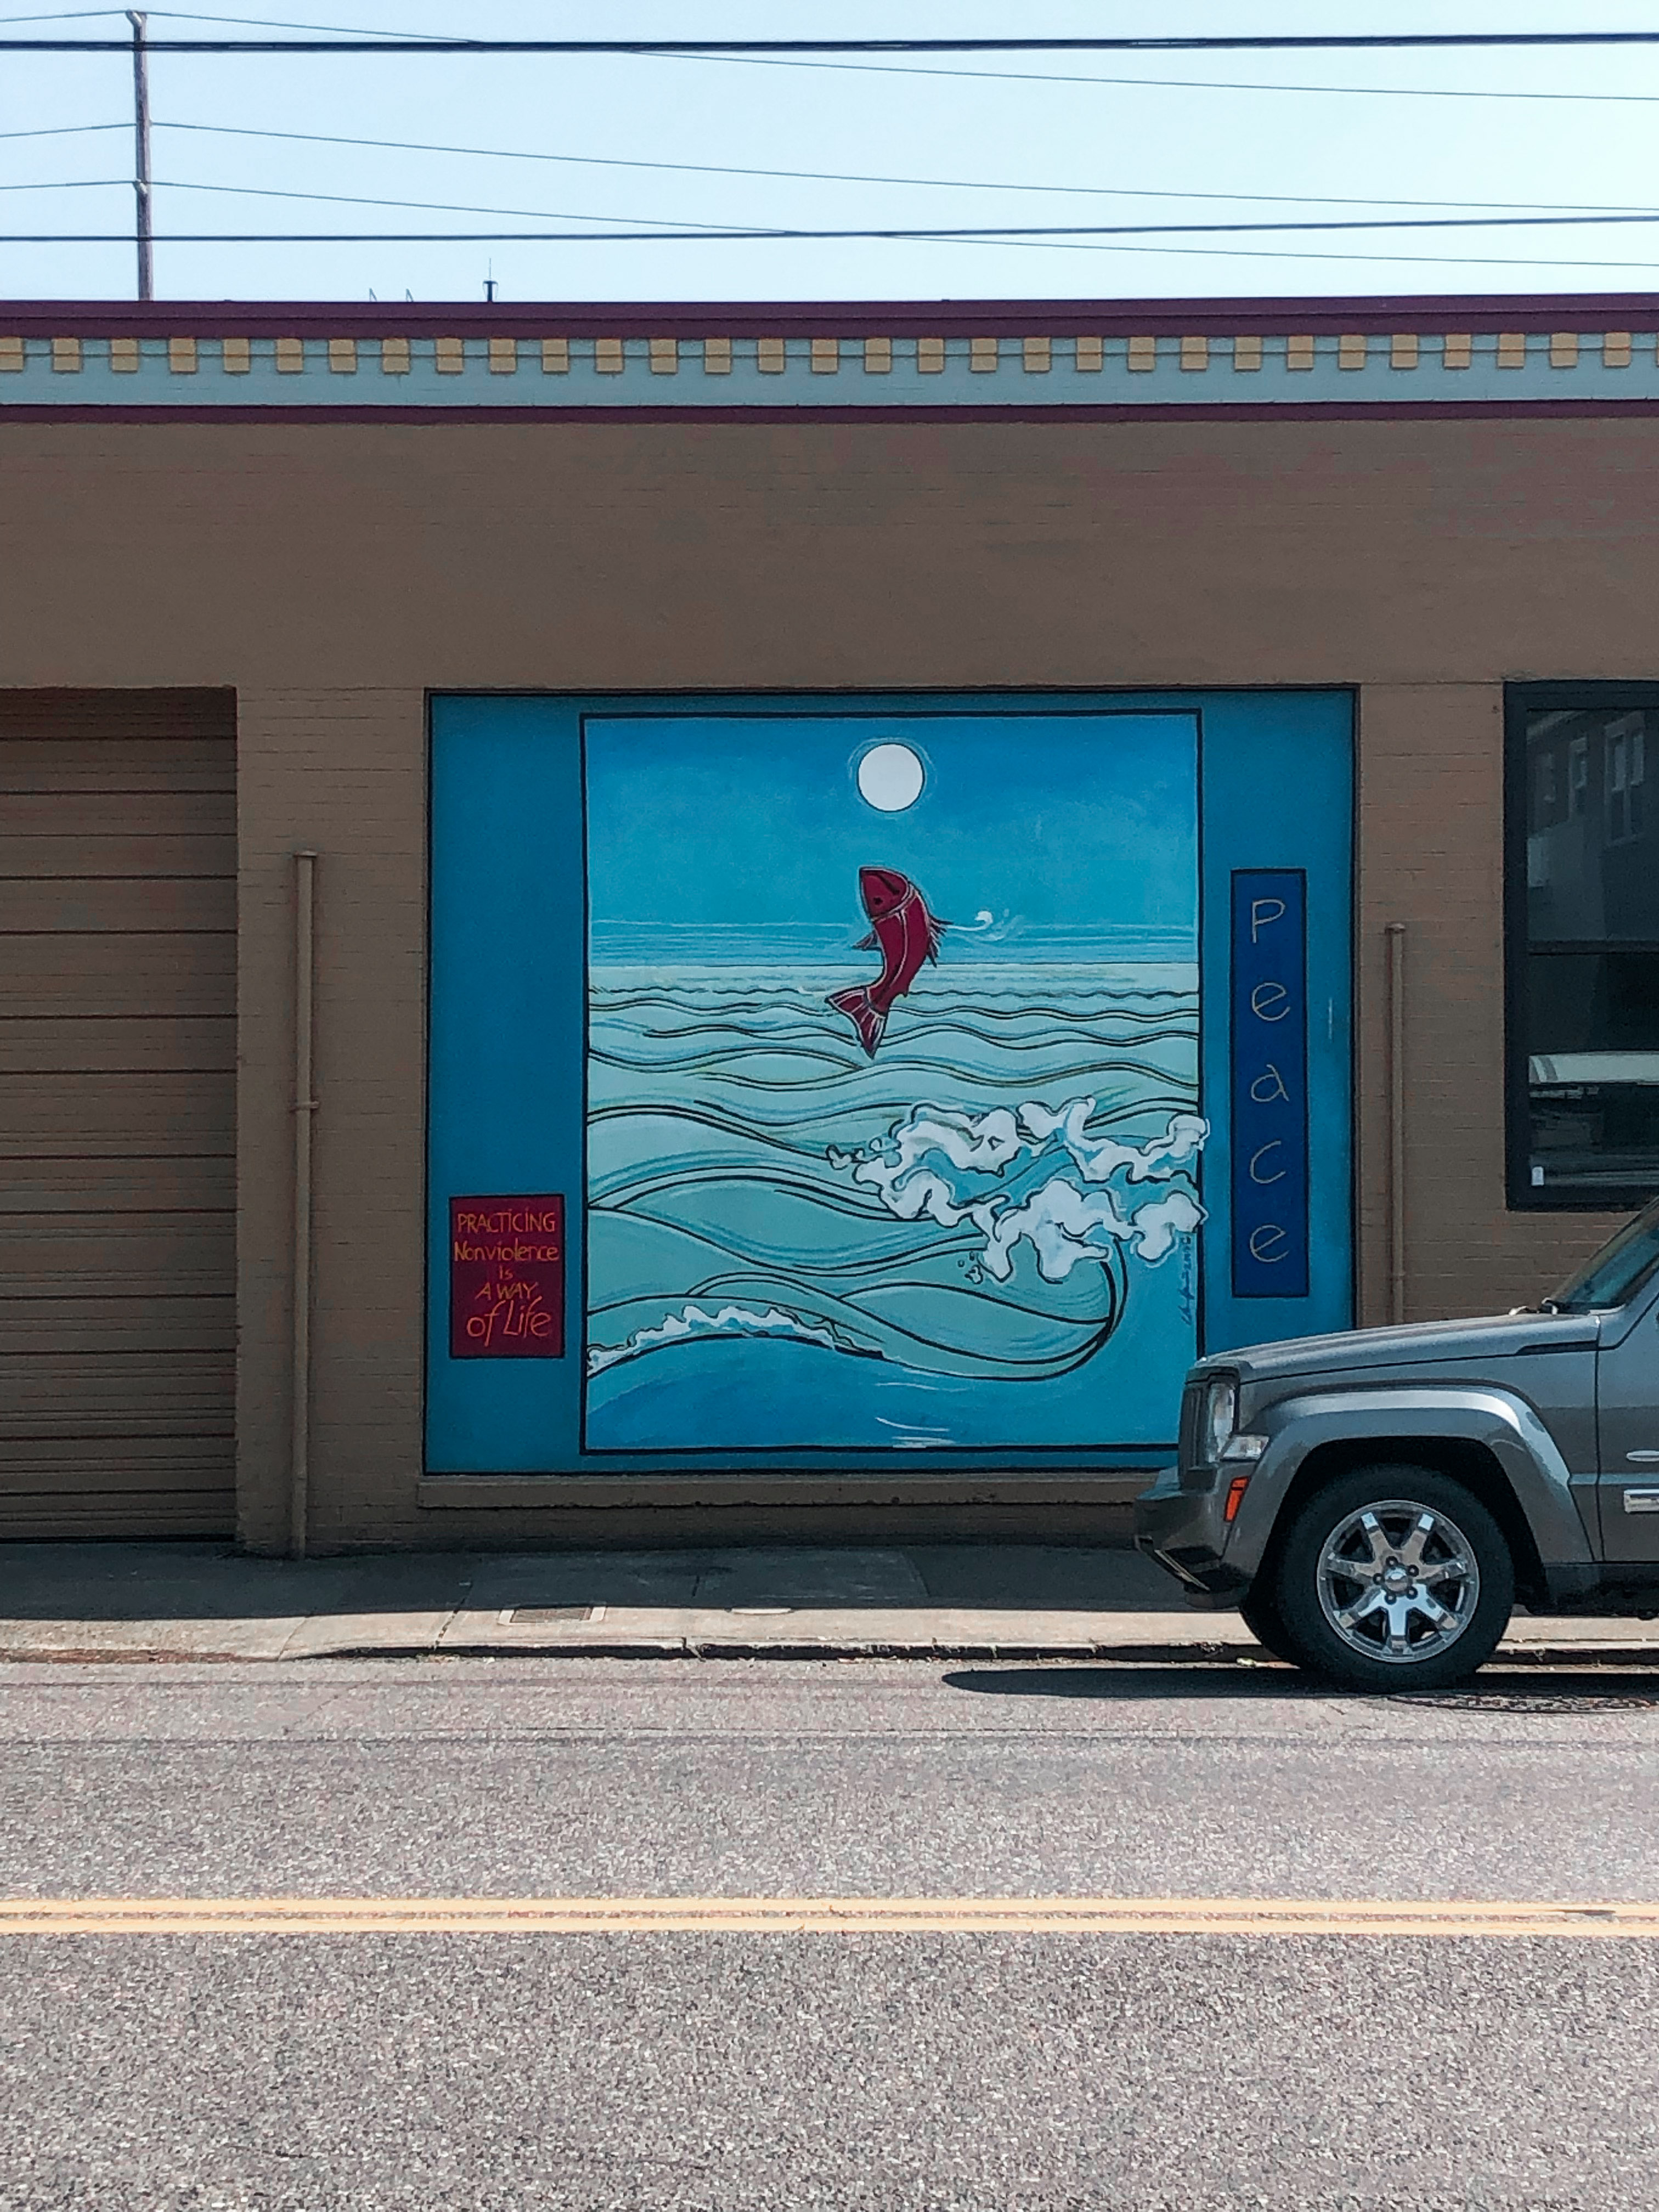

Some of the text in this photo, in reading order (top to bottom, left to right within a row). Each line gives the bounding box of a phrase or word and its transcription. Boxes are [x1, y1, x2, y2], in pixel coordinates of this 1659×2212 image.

[1250, 899, 1290, 1263] Peace
[458, 1207, 555, 1233] PRACTICING
[454, 1238, 559, 1261] Nonviolence
[475, 1282, 539, 1300] A WAY
[466, 1296, 551, 1346] of Life
